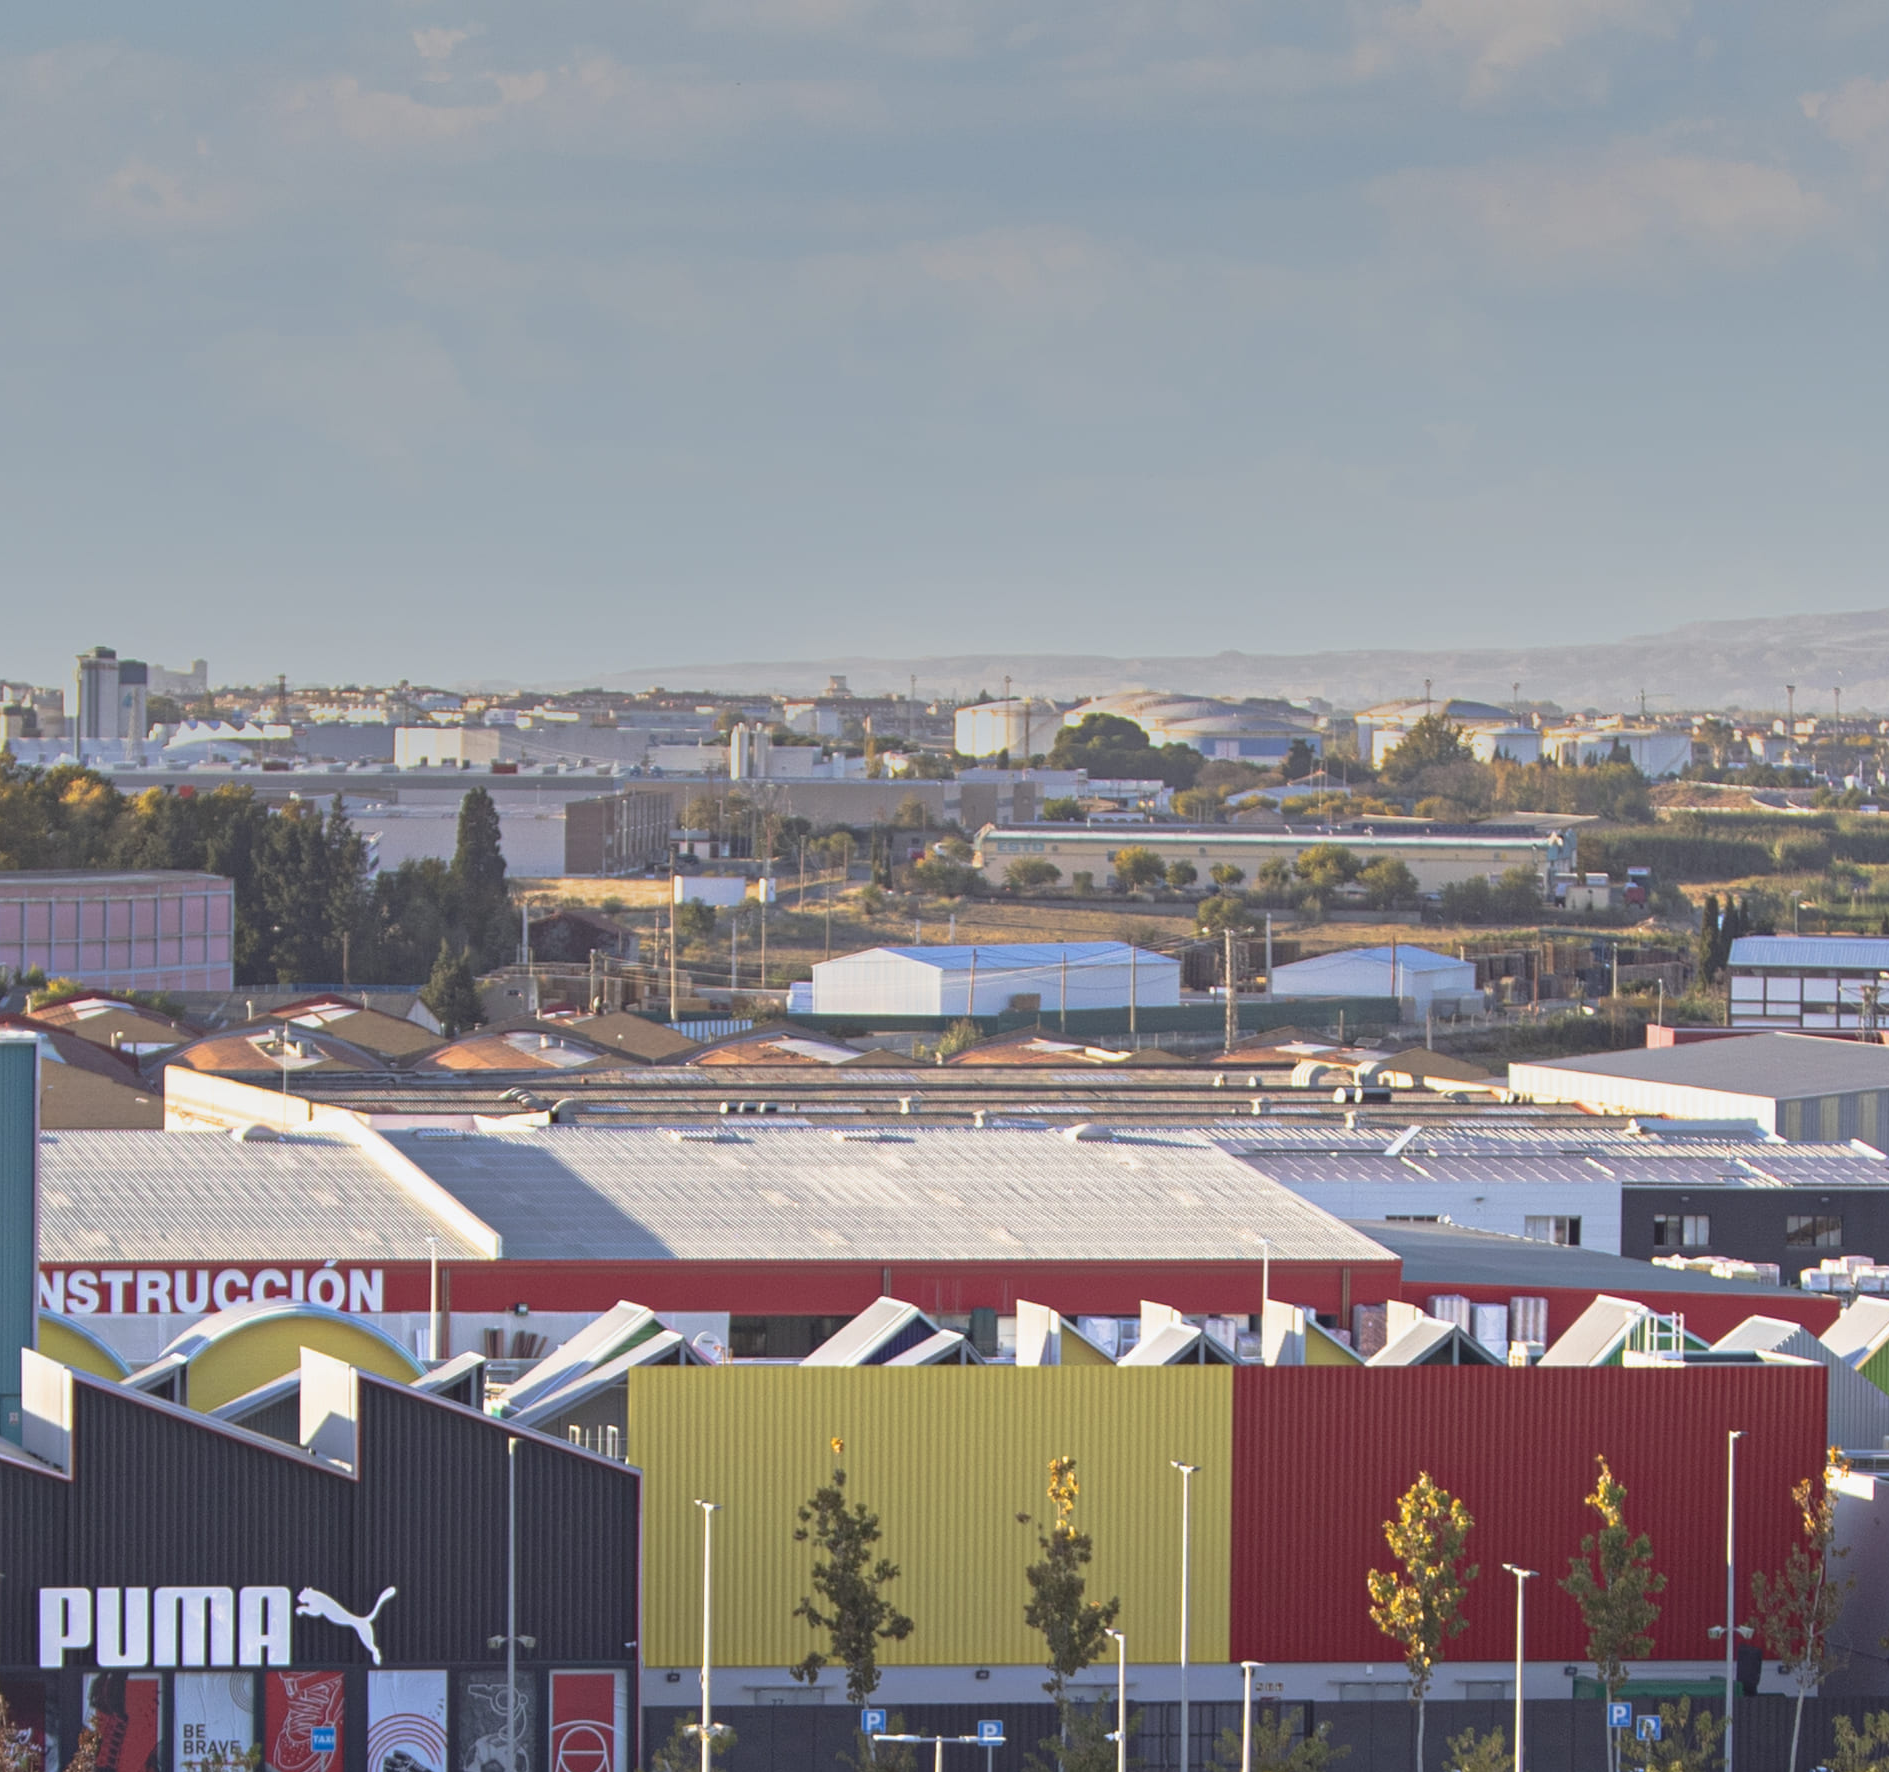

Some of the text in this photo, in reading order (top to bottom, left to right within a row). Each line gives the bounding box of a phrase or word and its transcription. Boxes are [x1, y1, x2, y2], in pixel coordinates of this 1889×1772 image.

[39, 1260, 384, 1314] NSTRUCCIÓN
[40, 1586, 291, 1667] PUMA
[183, 1724, 206, 1739] BE
[313, 1735, 335, 1744] TAXI
[183, 1740, 241, 1755] BRAVE
